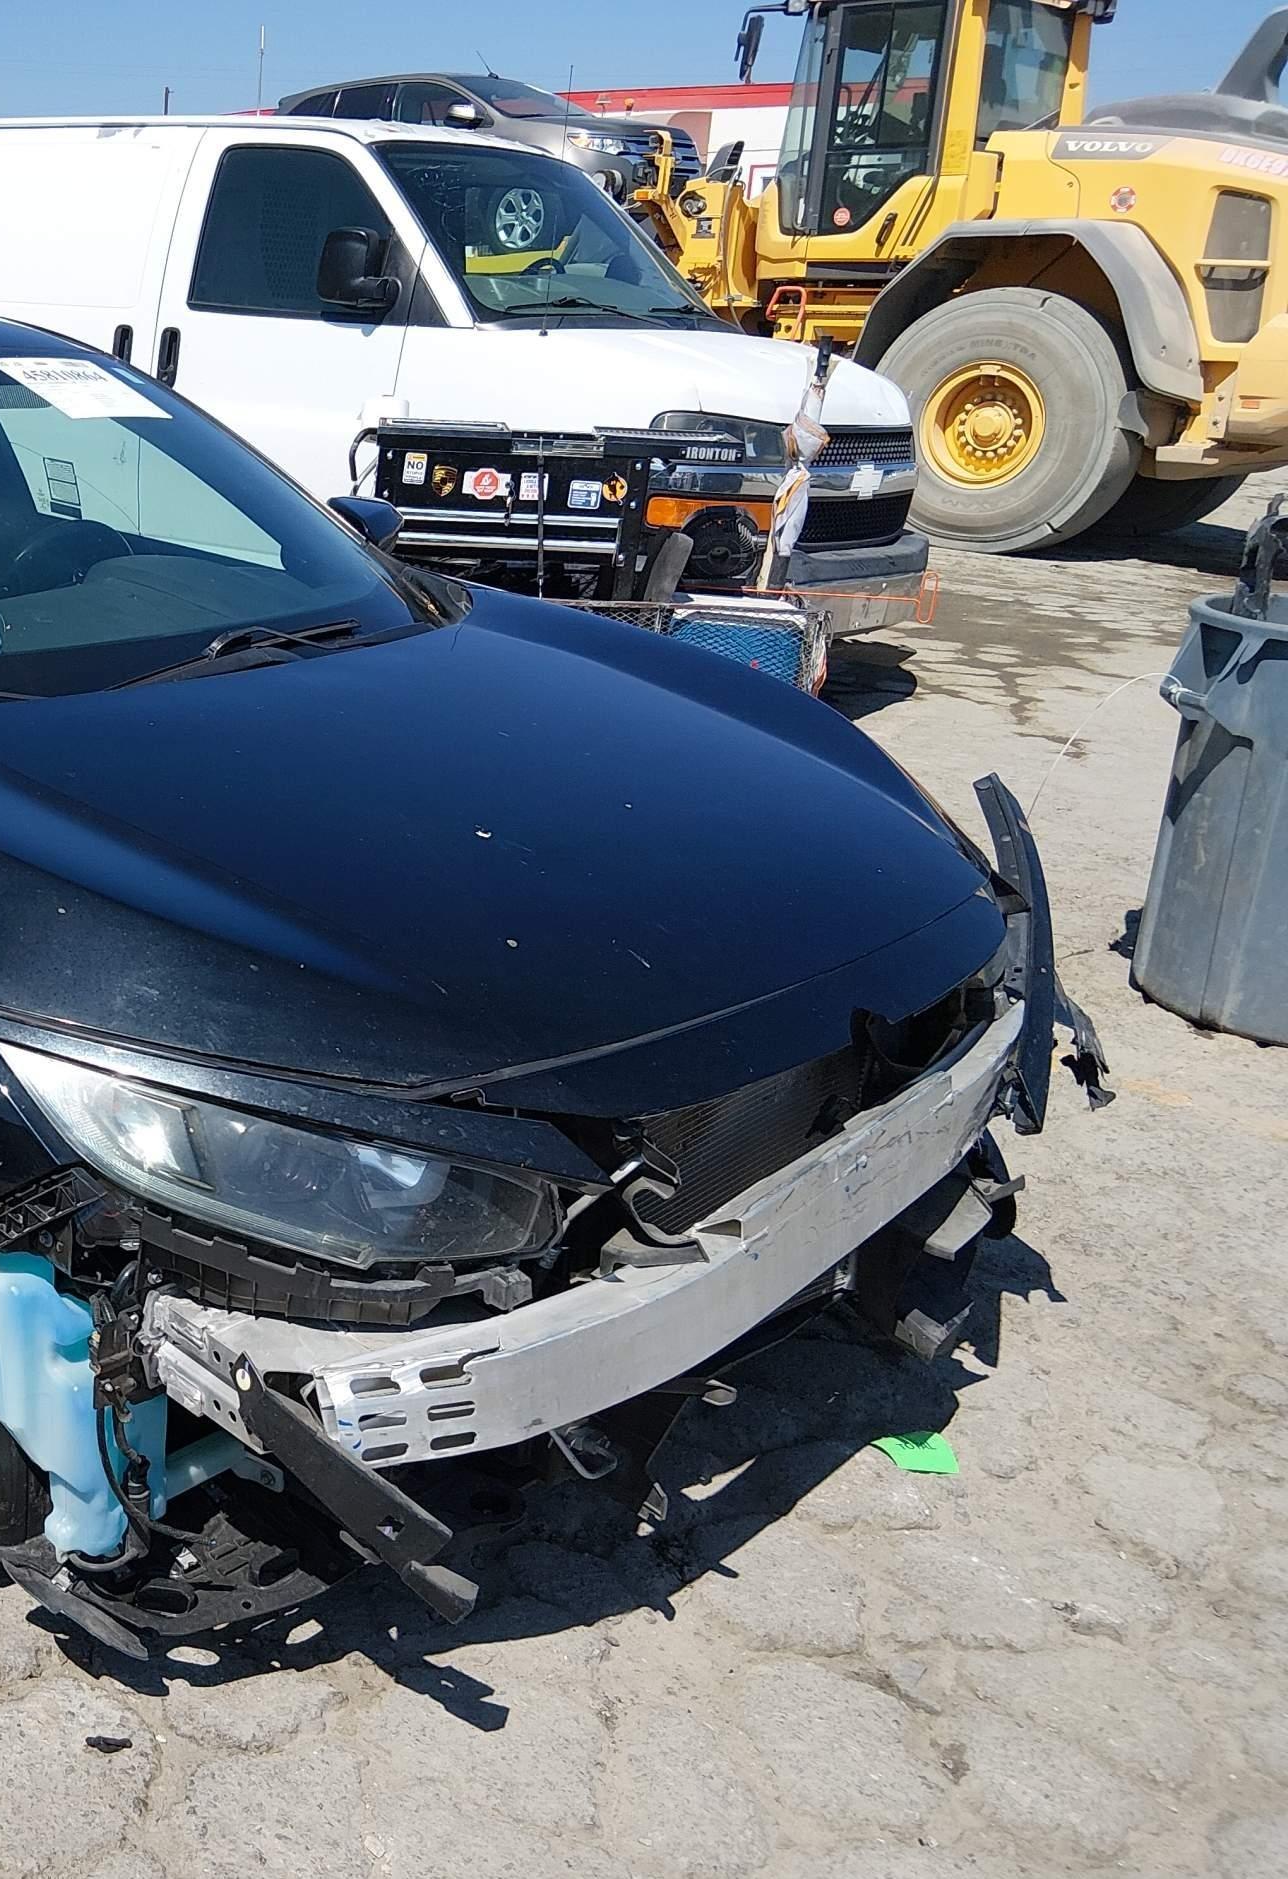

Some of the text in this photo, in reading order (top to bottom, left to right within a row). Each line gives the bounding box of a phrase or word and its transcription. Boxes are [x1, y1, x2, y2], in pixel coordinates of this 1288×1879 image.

[1065, 140, 1153, 153] VOLVO
[22, 369, 109, 382] 45810864
[685, 446, 737, 461] IRONTON
[406, 461, 424, 470] NO
